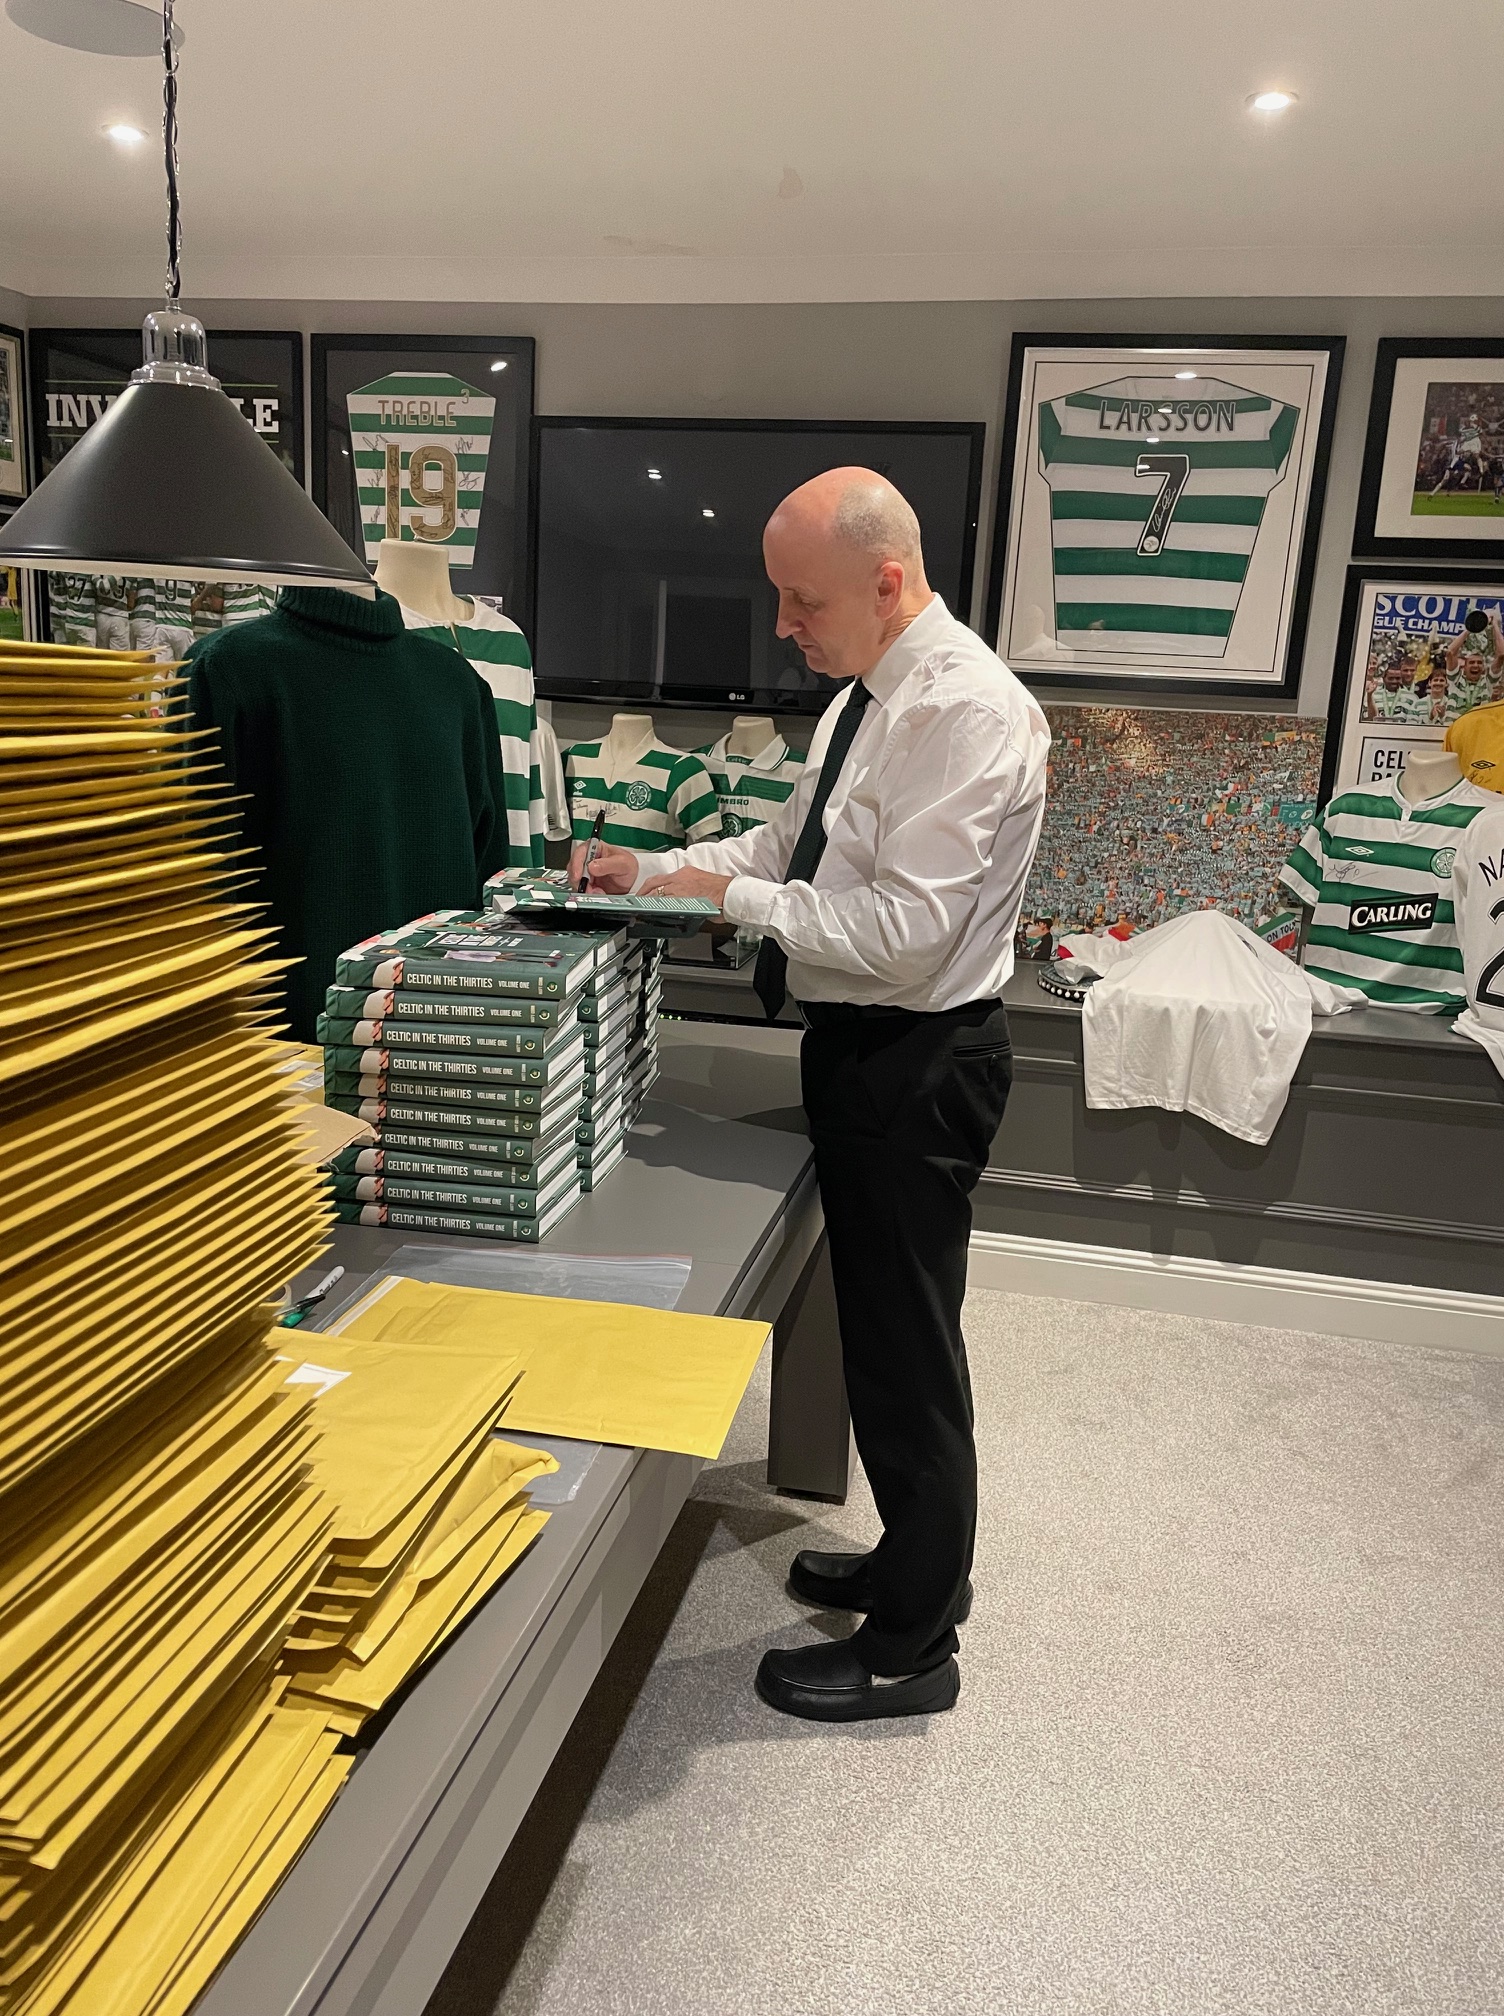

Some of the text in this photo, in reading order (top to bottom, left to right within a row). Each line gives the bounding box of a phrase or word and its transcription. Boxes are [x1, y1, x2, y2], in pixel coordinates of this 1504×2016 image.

[378, 389, 470, 427] TREBLE 3
[1099, 400, 1236, 433] LARSSON
[385, 442, 458, 542] 19
[1135, 454, 1191, 557] 7
[1373, 749, 1410, 770] CEL
[1351, 902, 1432, 927] CARLING
[407, 973, 432, 984] CELTIC
[433, 974, 441, 985] IN
[443, 975, 457, 987] THE
[459, 976, 492, 989] THIRTIES
[499, 980, 518, 989] VOLUME
[520, 981, 530, 989] ONE
[398, 1003, 423, 1014] CELTIC
[425, 1004, 432, 1015] IN
[434, 1004, 448, 1016] THE
[451, 1005, 484, 1017] THIRTIES
[490, 1009, 511, 1017] VOLUME
[512, 1009, 522, 1018] ONE
[386, 1030, 410, 1042] CELTIC
[412, 1032, 420, 1043] IN
[422, 1033, 436, 1044] THE
[438, 1033, 471, 1046] THIRTIES
[477, 1038, 496, 1046] VOLUME
[497, 1039, 507, 1047] ONE
[393, 1058, 417, 1070] CELTIC
[419, 1060, 426, 1070] IN
[428, 1061, 442, 1072] THE
[444, 1061, 477, 1074] THIRTIES
[482, 1066, 502, 1075] VOLUME
[503, 1067, 513, 1076] ONE
[391, 1082, 414, 1094] CELTIC
[415, 1084, 422, 1095] IN
[424, 1085, 438, 1096] THE
[440, 1086, 471, 1099] THIRTIES
[497, 1093, 506, 1101] ONE
[391, 1109, 413, 1120] CELTIC
[415, 1110, 422, 1121] IN
[424, 1111, 438, 1122] THE
[439, 1112, 471, 1125] THIRTIES
[497, 1118, 506, 1127] ONE
[385, 1133, 407, 1144] CELTIC
[409, 1134, 416, 1145] IN
[418, 1136, 431, 1147] THE
[433, 1137, 463, 1150] THIRTIES
[489, 1144, 498, 1153] ONE
[388, 1160, 410, 1171] CELTIC
[412, 1162, 419, 1172] IN
[421, 1163, 435, 1174] THE
[436, 1164, 468, 1176] THIRTIES
[474, 1169, 492, 1177] VOLUME
[494, 1170, 503, 1178] ONE
[388, 1187, 410, 1198] CELTIC
[412, 1188, 419, 1200] IN
[421, 1190, 434, 1201] THE
[436, 1191, 467, 1204] THIRTIES
[473, 1196, 491, 1204] VOLUME
[492, 1198, 501, 1206] ONE
[392, 1213, 414, 1224] CELTIC
[416, 1214, 423, 1225] IN
[424, 1215, 438, 1227] THE
[439, 1217, 470, 1230] THIRTIES
[476, 1222, 494, 1230] VOLUME
[495, 1223, 505, 1232] ONE
